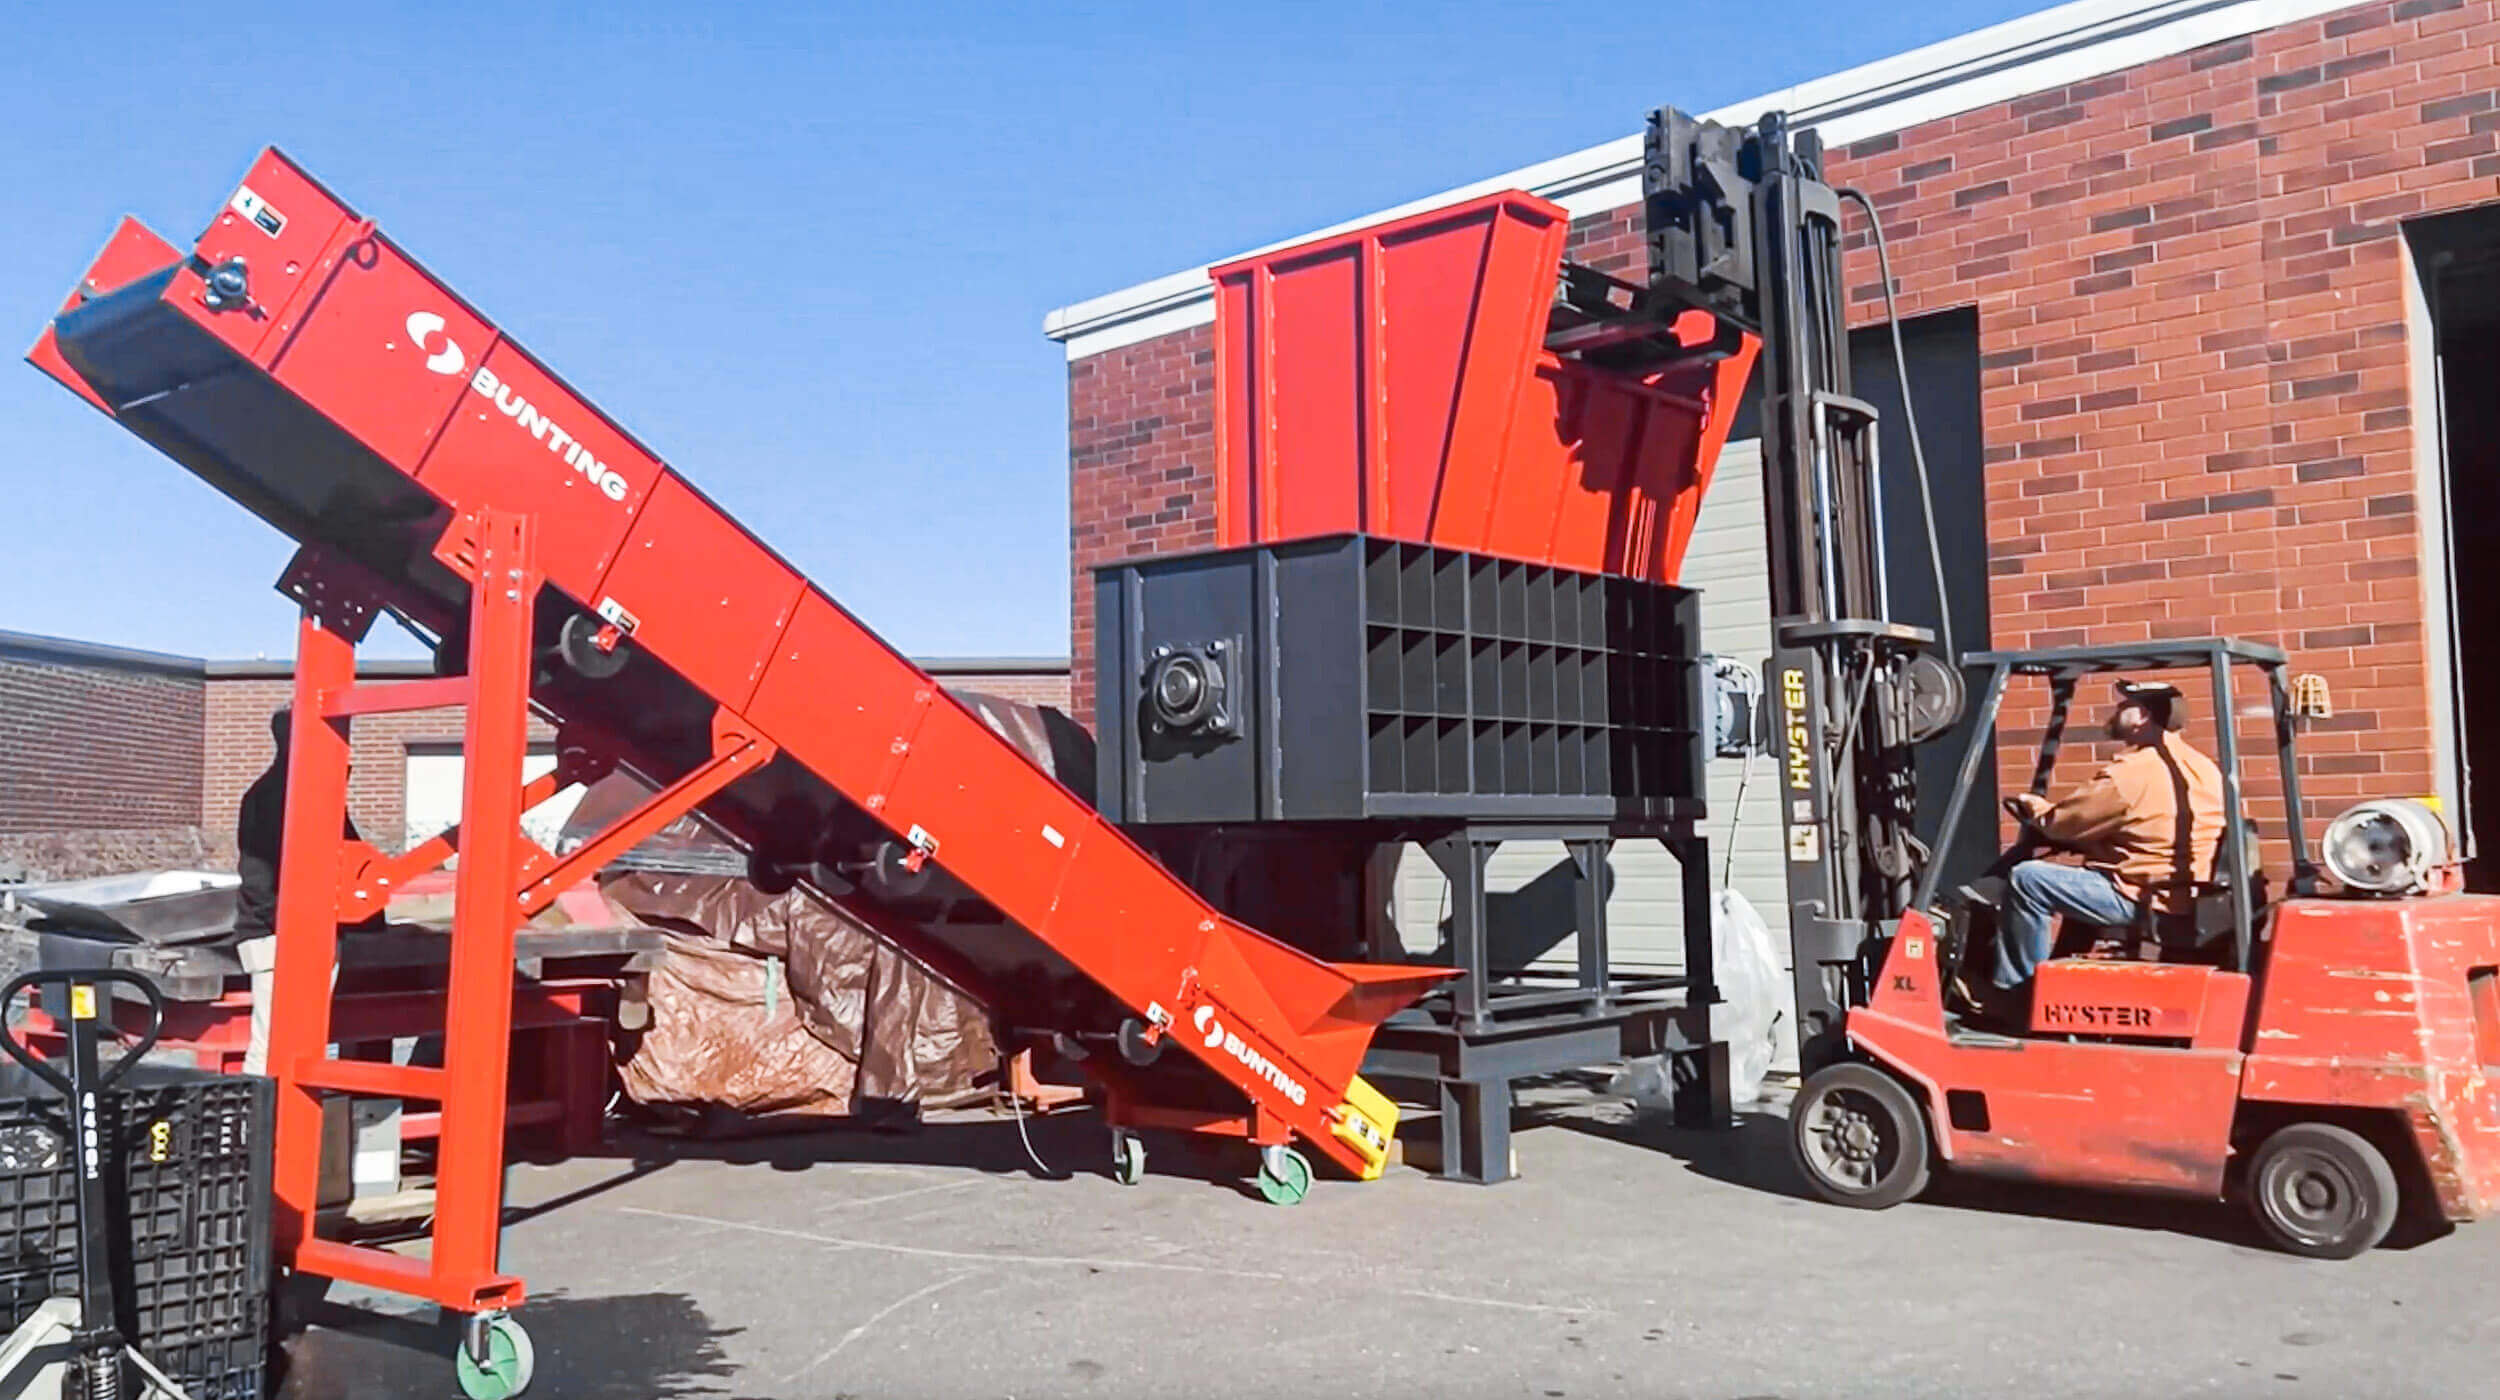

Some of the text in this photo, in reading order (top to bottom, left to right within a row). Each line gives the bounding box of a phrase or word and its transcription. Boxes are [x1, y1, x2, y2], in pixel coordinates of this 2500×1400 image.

[471, 366, 628, 501] BUNTING
[1783, 668, 1812, 789] HYSTER
[1893, 975, 1916, 992] XL
[2044, 1003, 2152, 1027] HYSTER
[1223, 1031, 1307, 1106] BUNTING
